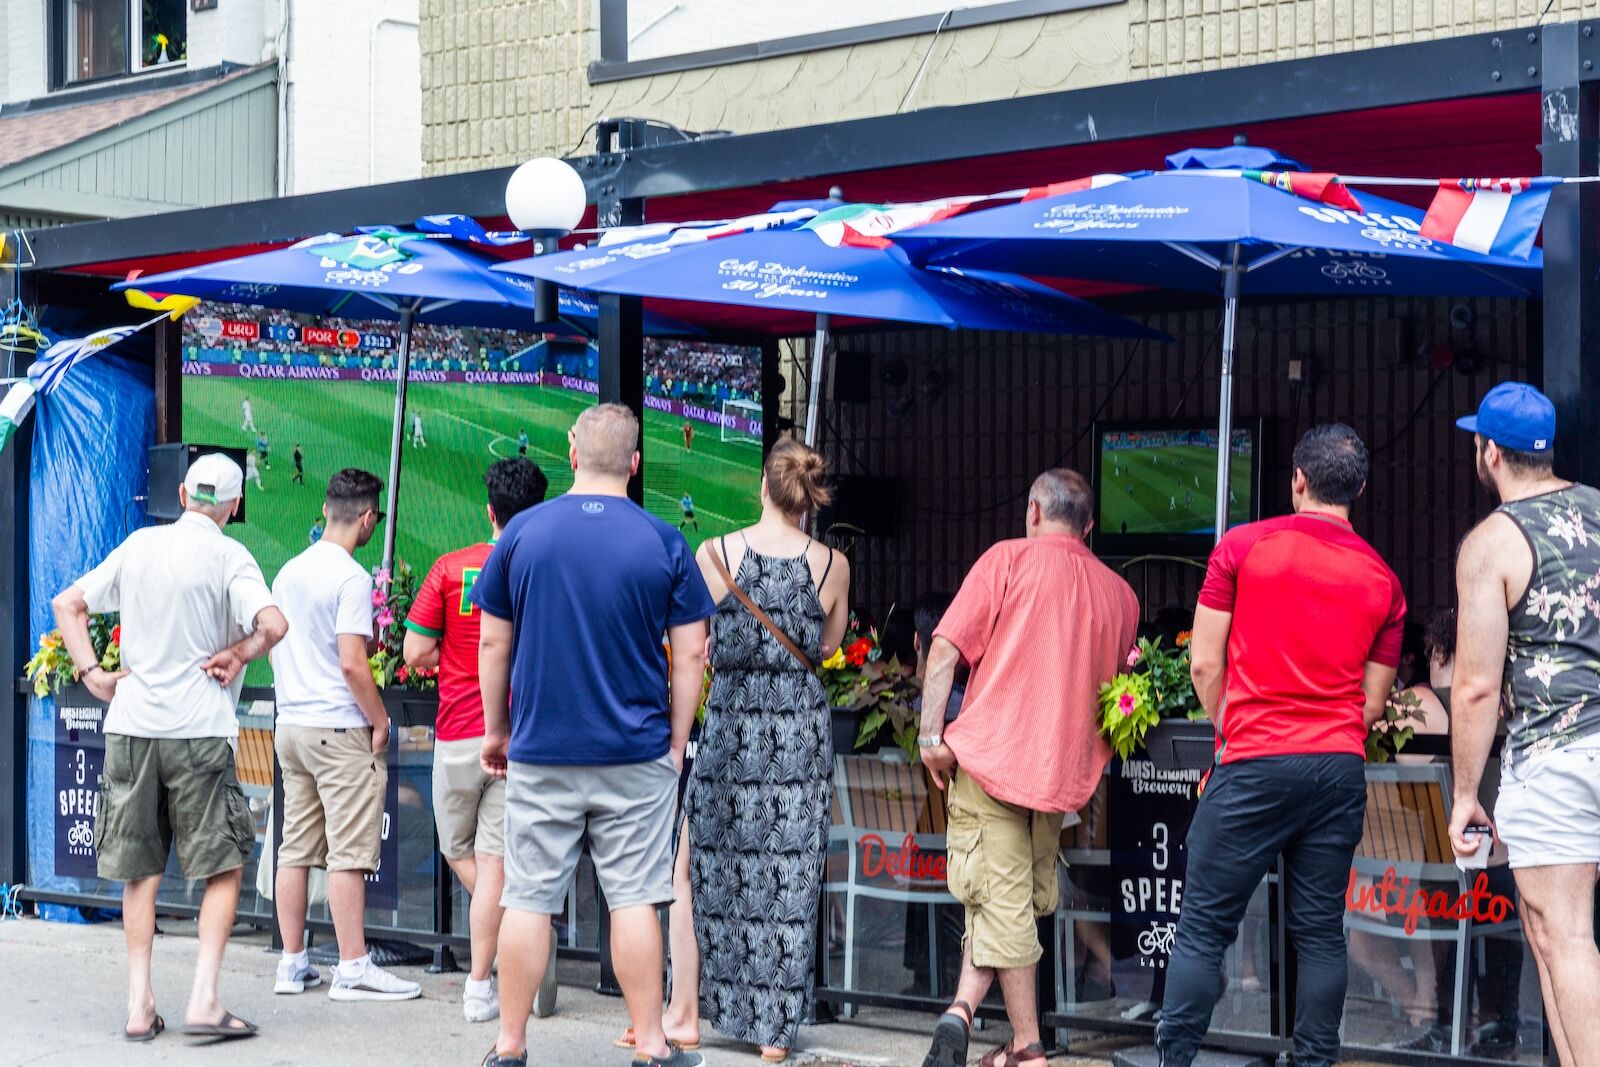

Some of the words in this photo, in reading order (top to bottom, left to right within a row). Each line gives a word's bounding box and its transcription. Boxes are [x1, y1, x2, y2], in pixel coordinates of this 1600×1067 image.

[228, 324, 255, 337] URU
[308, 330, 333, 343] POR
[239, 363, 285, 378] QATAR
[288, 365, 341, 380] AIRWAYS
[407, 370, 447, 382] IRWAYS
[465, 371, 498, 383] QATAR
[500, 372, 539, 385] AIRWAYS
[683, 404, 706, 421] QATAR
[75, 748, 86, 785] 3
[1131, 777, 1191, 801] Brewery
[1152, 822, 1169, 872] 3
[1120, 877, 1183, 916] SPEE
